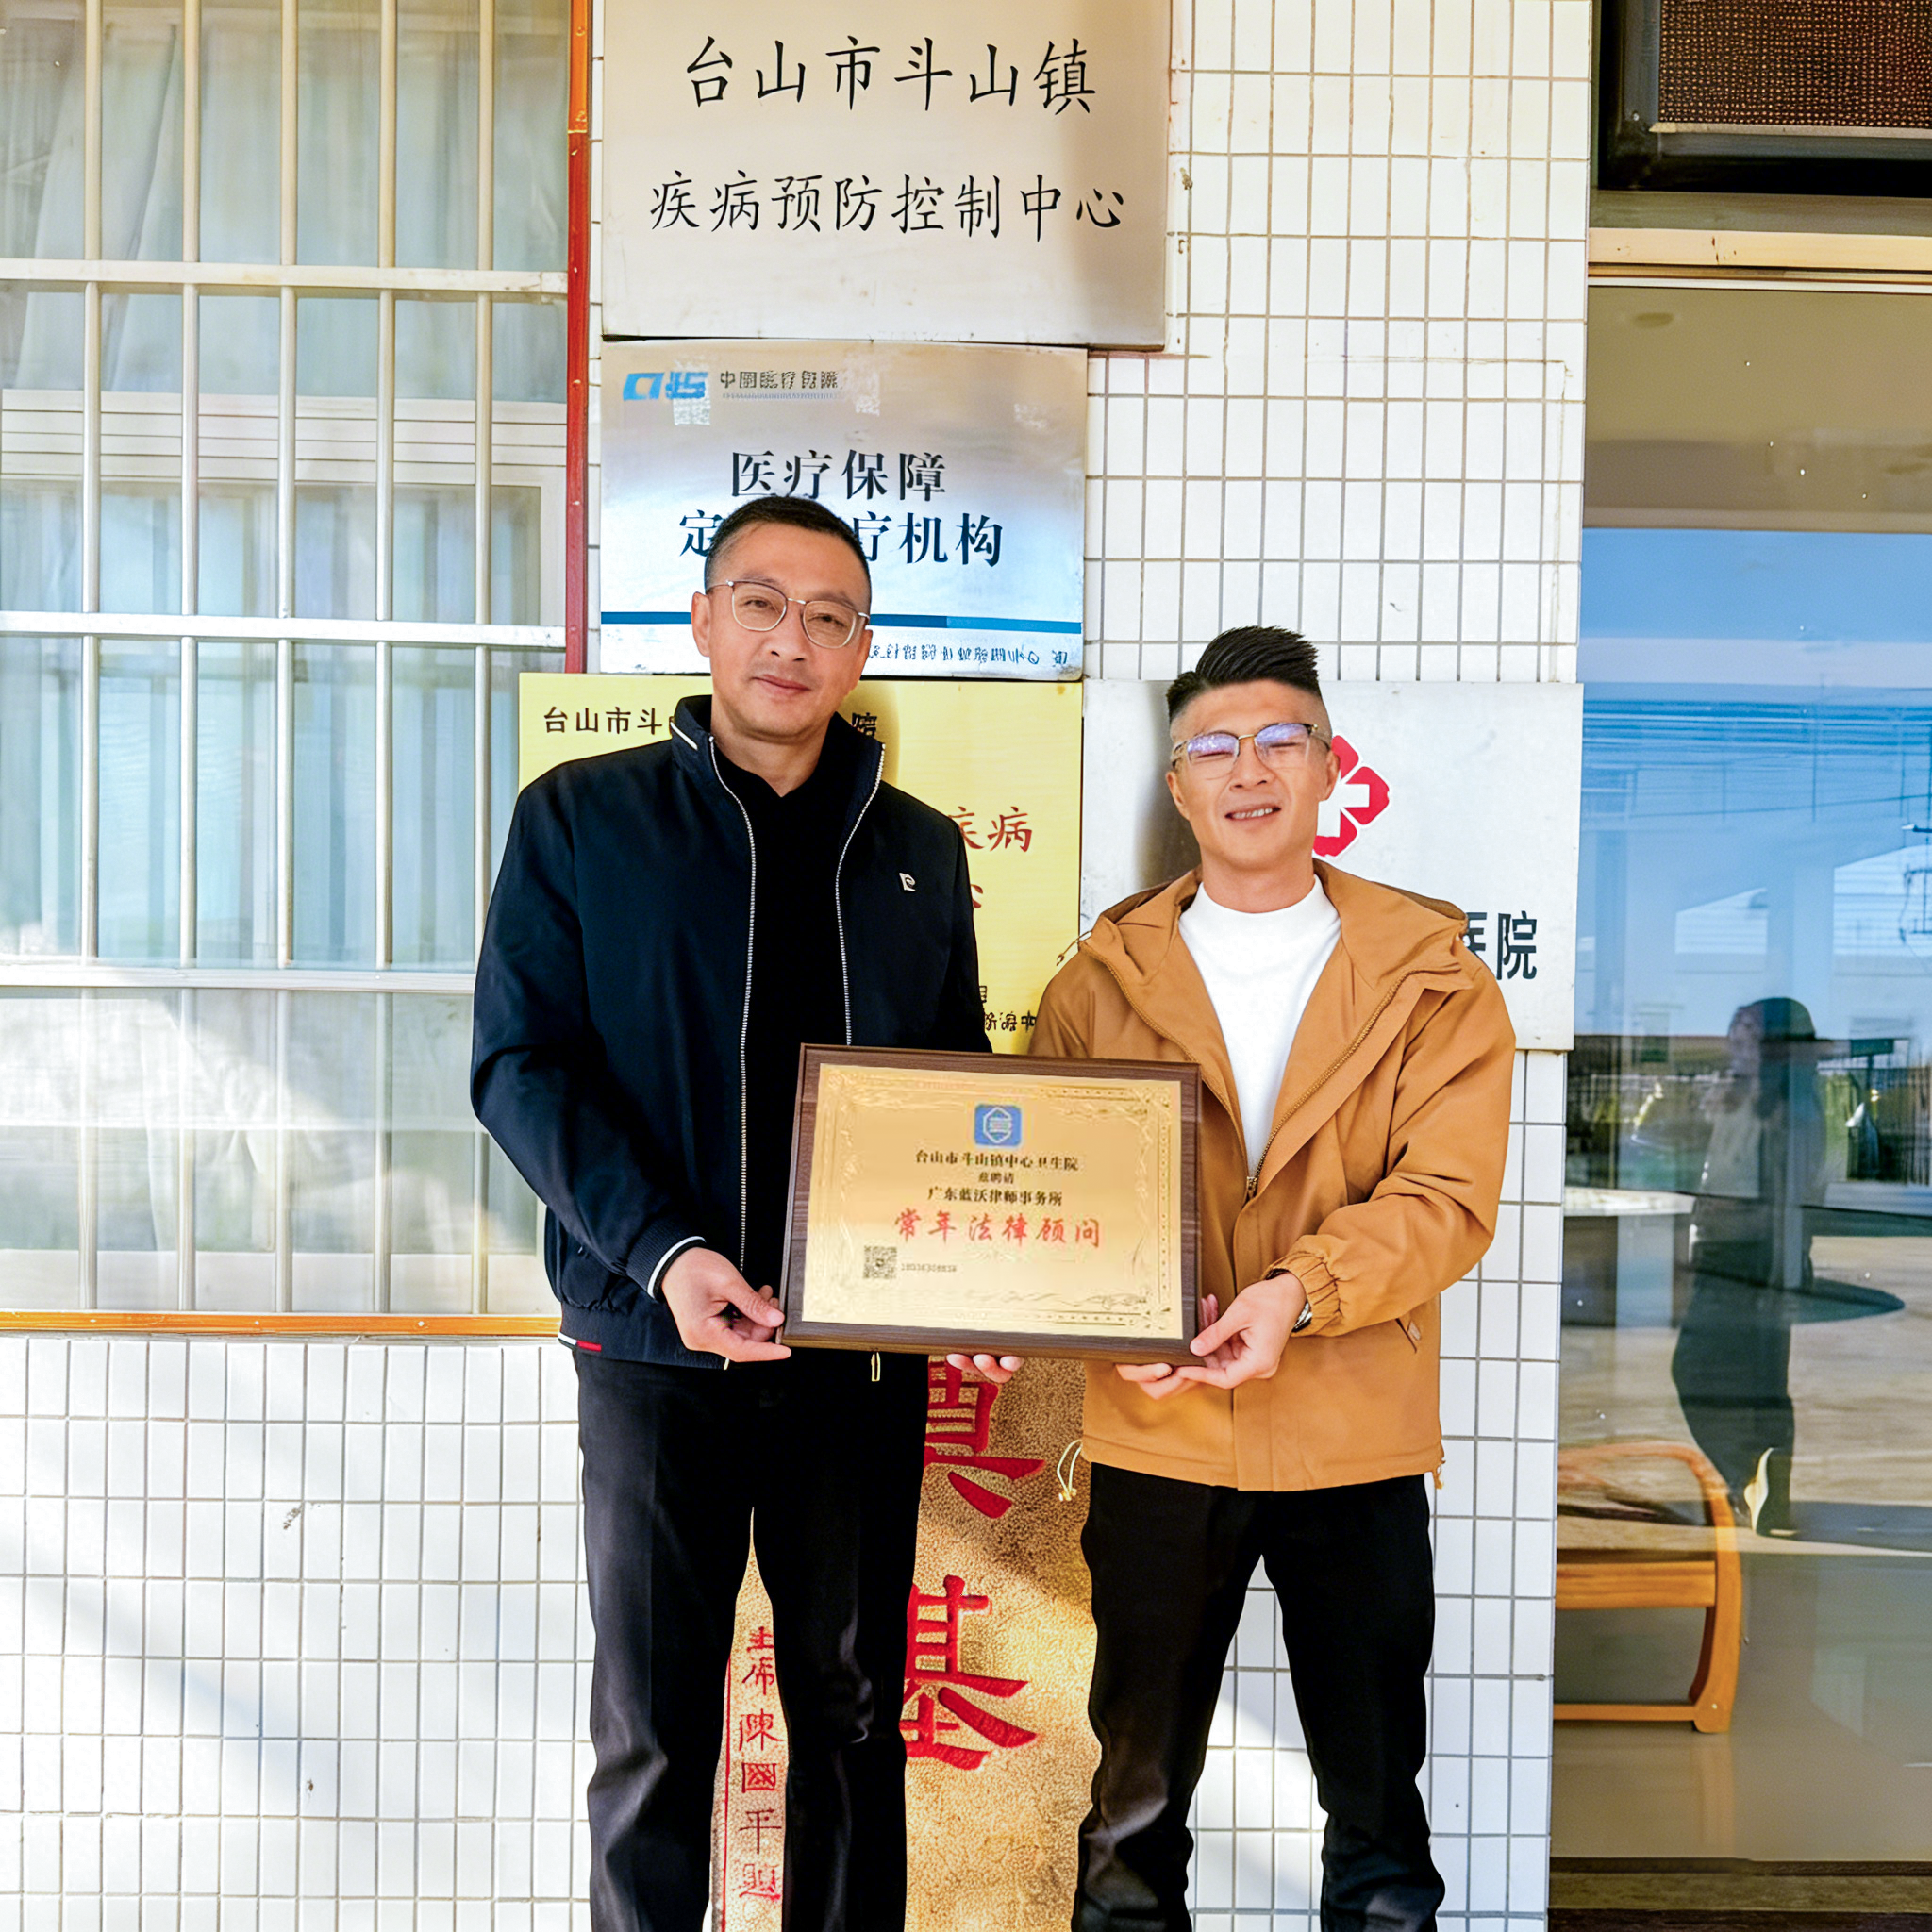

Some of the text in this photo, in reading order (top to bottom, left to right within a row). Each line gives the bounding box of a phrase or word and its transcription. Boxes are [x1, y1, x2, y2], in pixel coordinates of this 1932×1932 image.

[686, 35, 1096, 115] 台山市斗山镇
[650, 169, 1124, 242] 疾病预防控制中心
[732, 449, 946, 502] 医疗保障
[679, 509, 1003, 568] 定疗机构
[543, 706, 674, 735] 台山市斗
[895, 1208, 1099, 1248] 常年法律顾问
